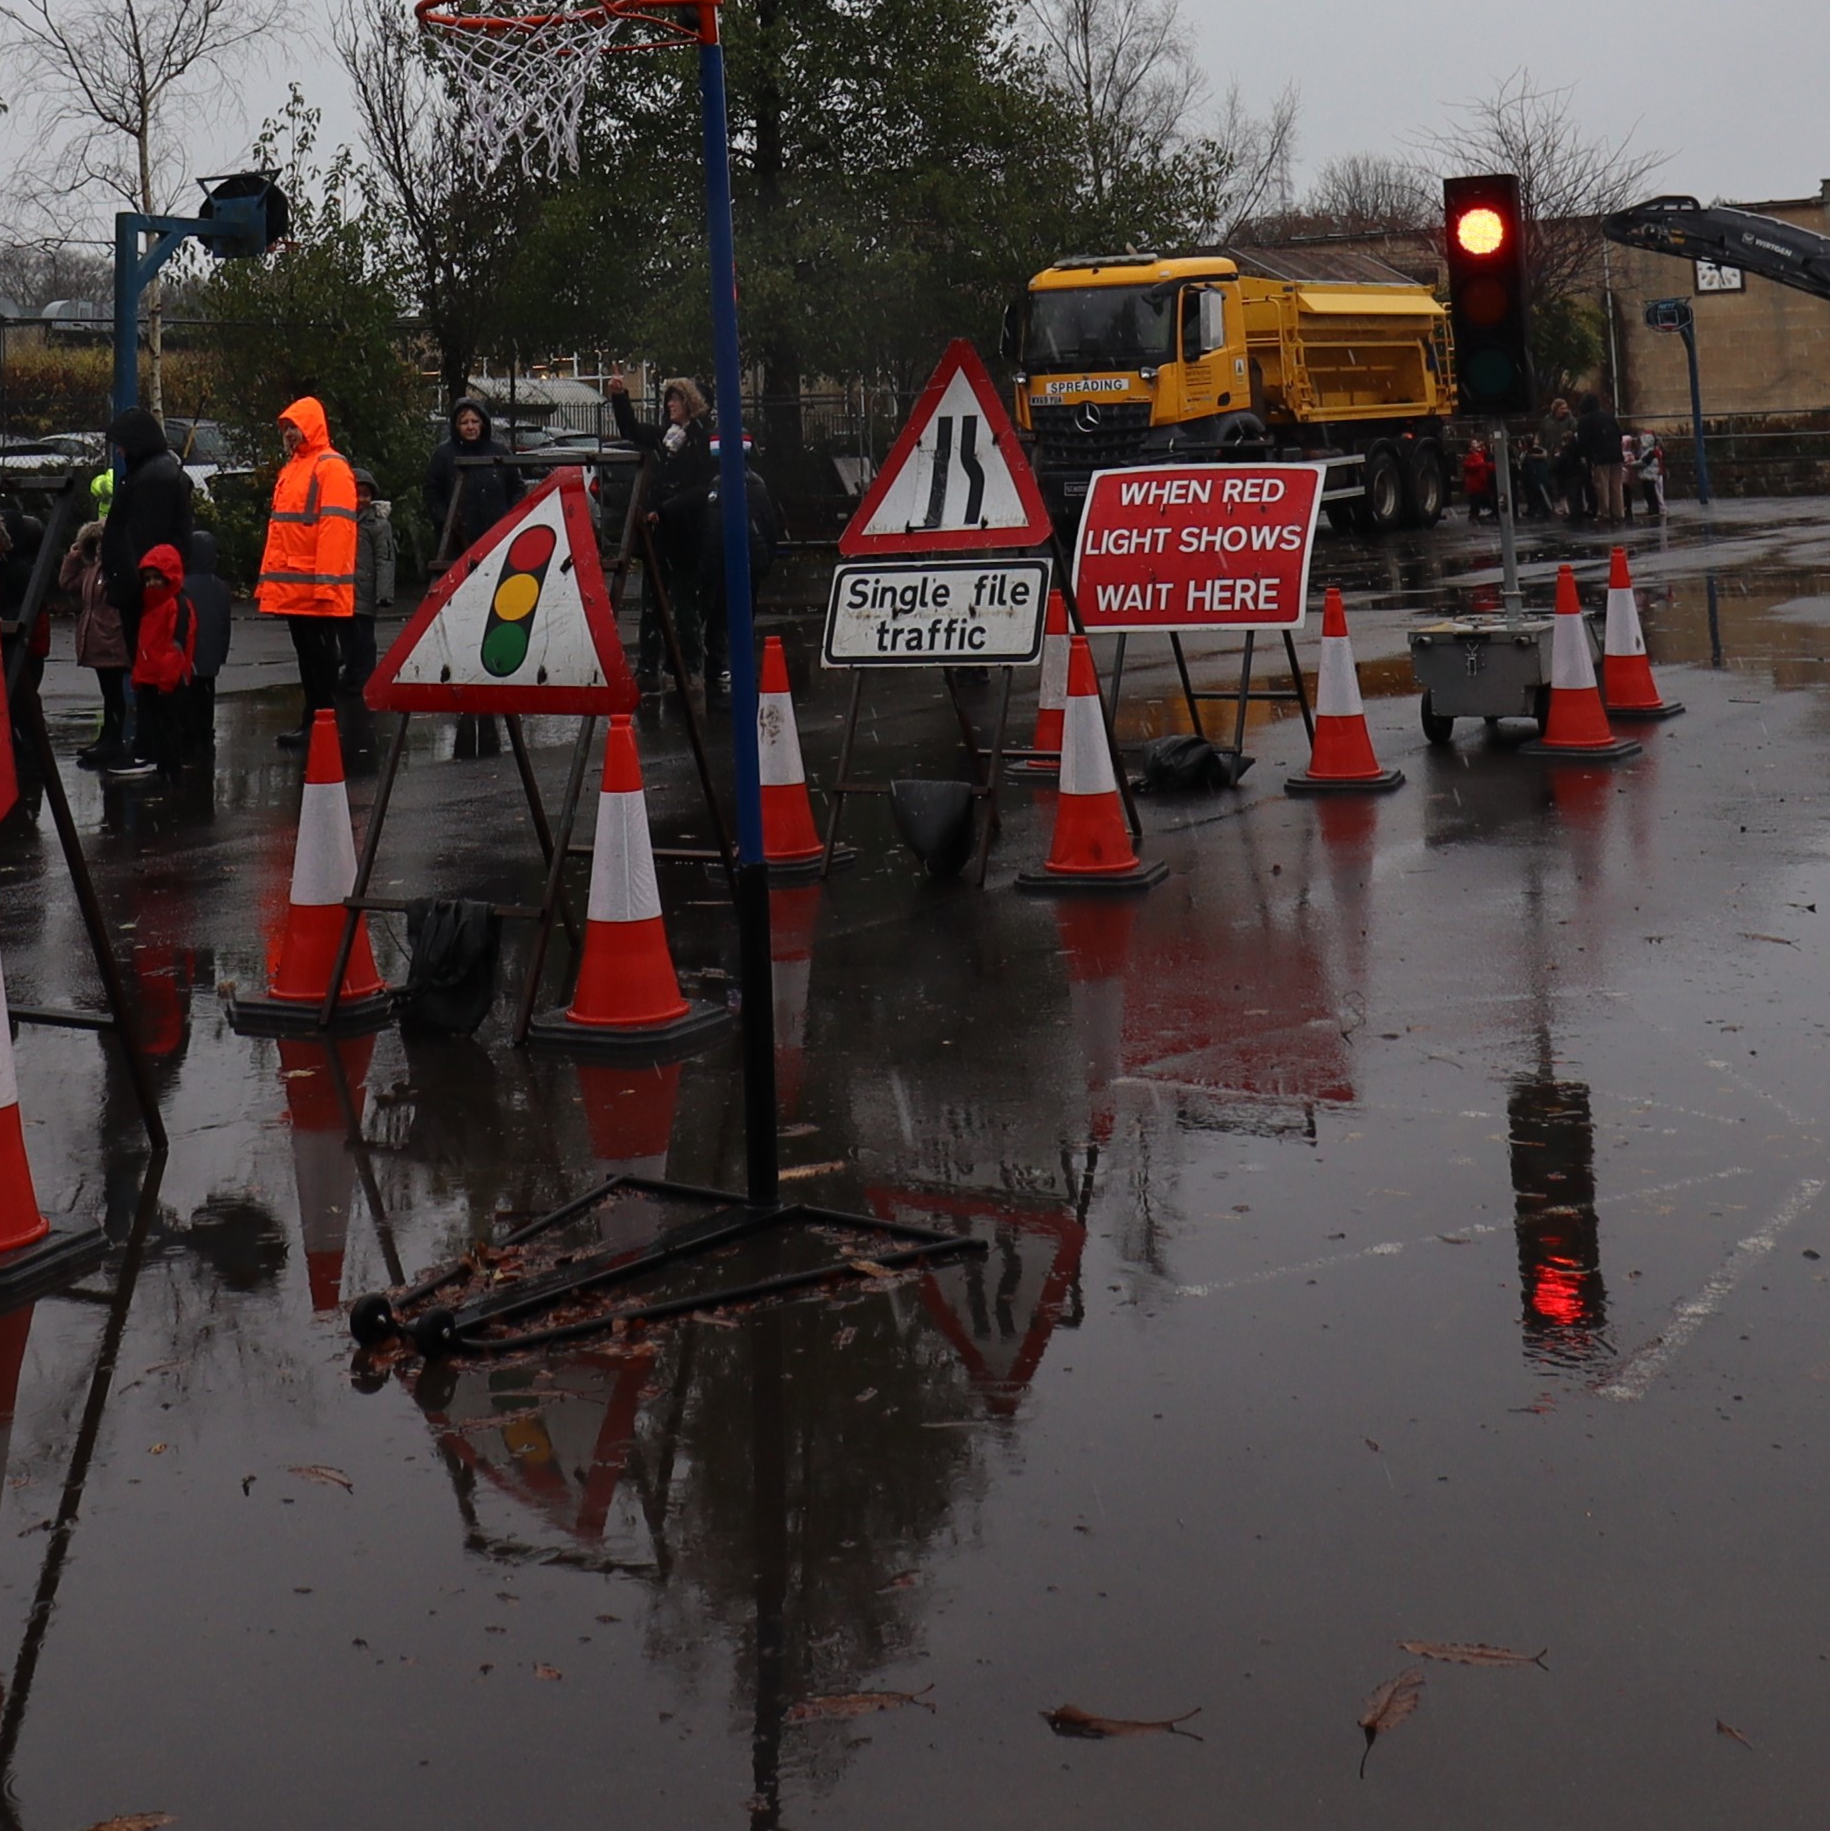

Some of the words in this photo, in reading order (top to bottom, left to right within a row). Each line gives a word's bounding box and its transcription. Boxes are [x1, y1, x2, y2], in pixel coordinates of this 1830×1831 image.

[1755, 238, 1793, 257] WIRTGEN
[1050, 378, 1123, 394] SPREADING
[1121, 479, 1212, 506] WHEN
[1222, 477, 1285, 503] RED
[1084, 527, 1172, 555] LIGHT
[1178, 525, 1303, 553] SHOWS
[845, 576, 951, 615] Single
[973, 573, 1030, 607] file
[1095, 582, 1174, 612] WAIT
[1186, 577, 1281, 612] HERE
[876, 617, 987, 652] traffic
